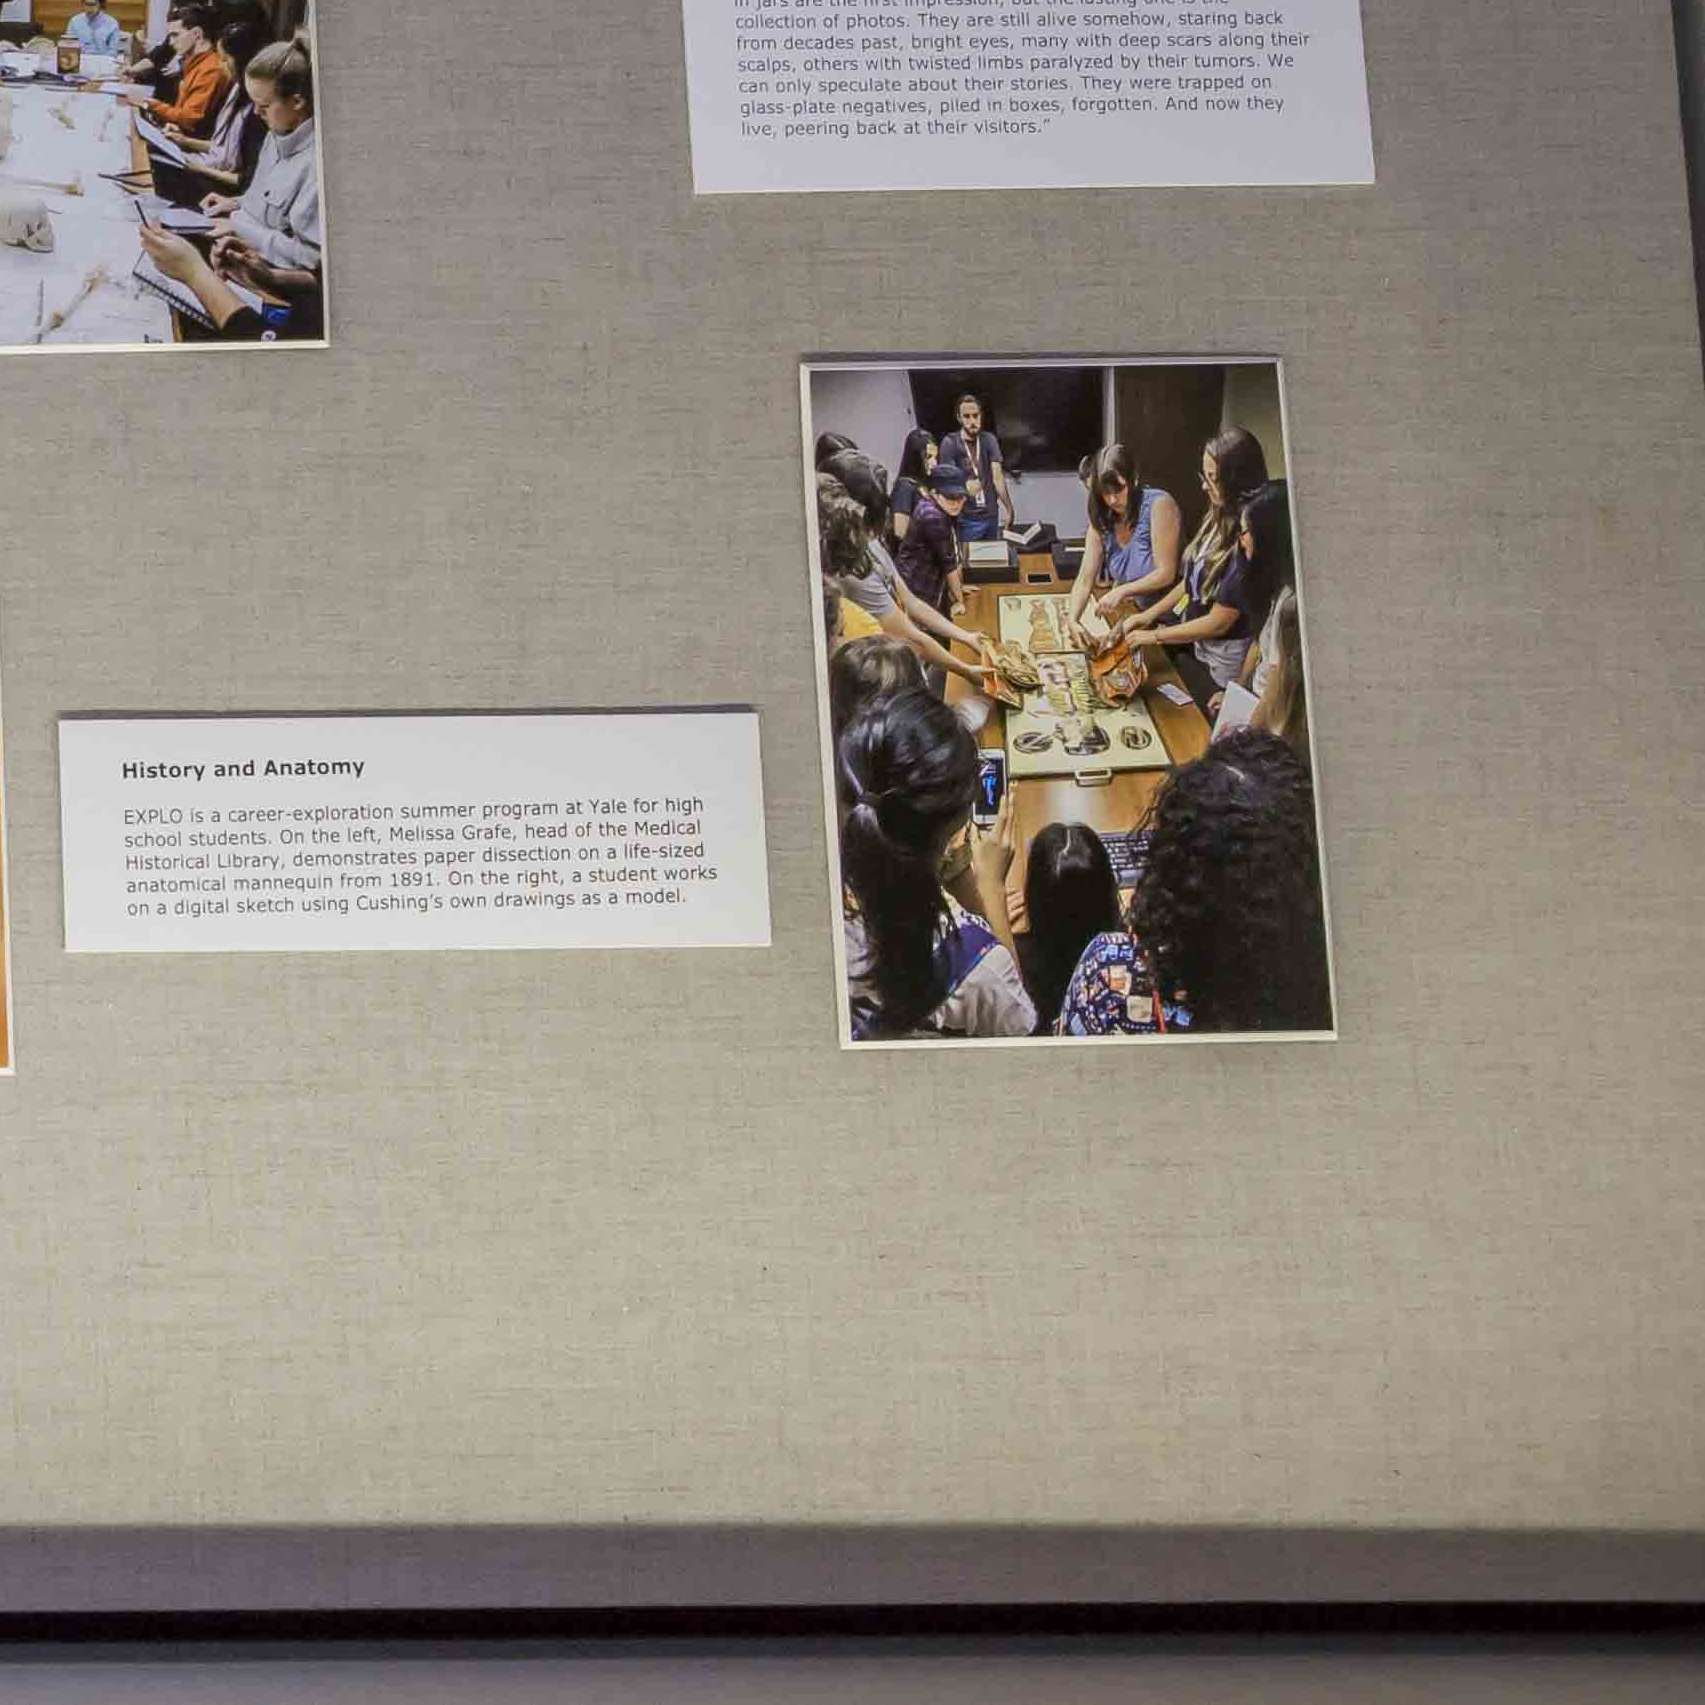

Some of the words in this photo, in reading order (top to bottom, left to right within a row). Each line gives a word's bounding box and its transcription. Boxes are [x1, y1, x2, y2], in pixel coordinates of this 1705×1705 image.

[122, 761, 205, 781] History
[214, 759, 255, 777] and
[263, 759, 364, 778] Anatomy
[126, 875, 226, 893] anatomical
[233, 875, 333, 893] mannequin
[340, 872, 381, 888] from
[390, 871, 440, 888] 1891.
[448, 870, 473, 886] On
[480, 869, 509, 885] the
[516, 868, 564, 888] right,
[572, 870, 581, 883] a
[588, 866, 658, 883] student
[663, 864, 717, 881] works
